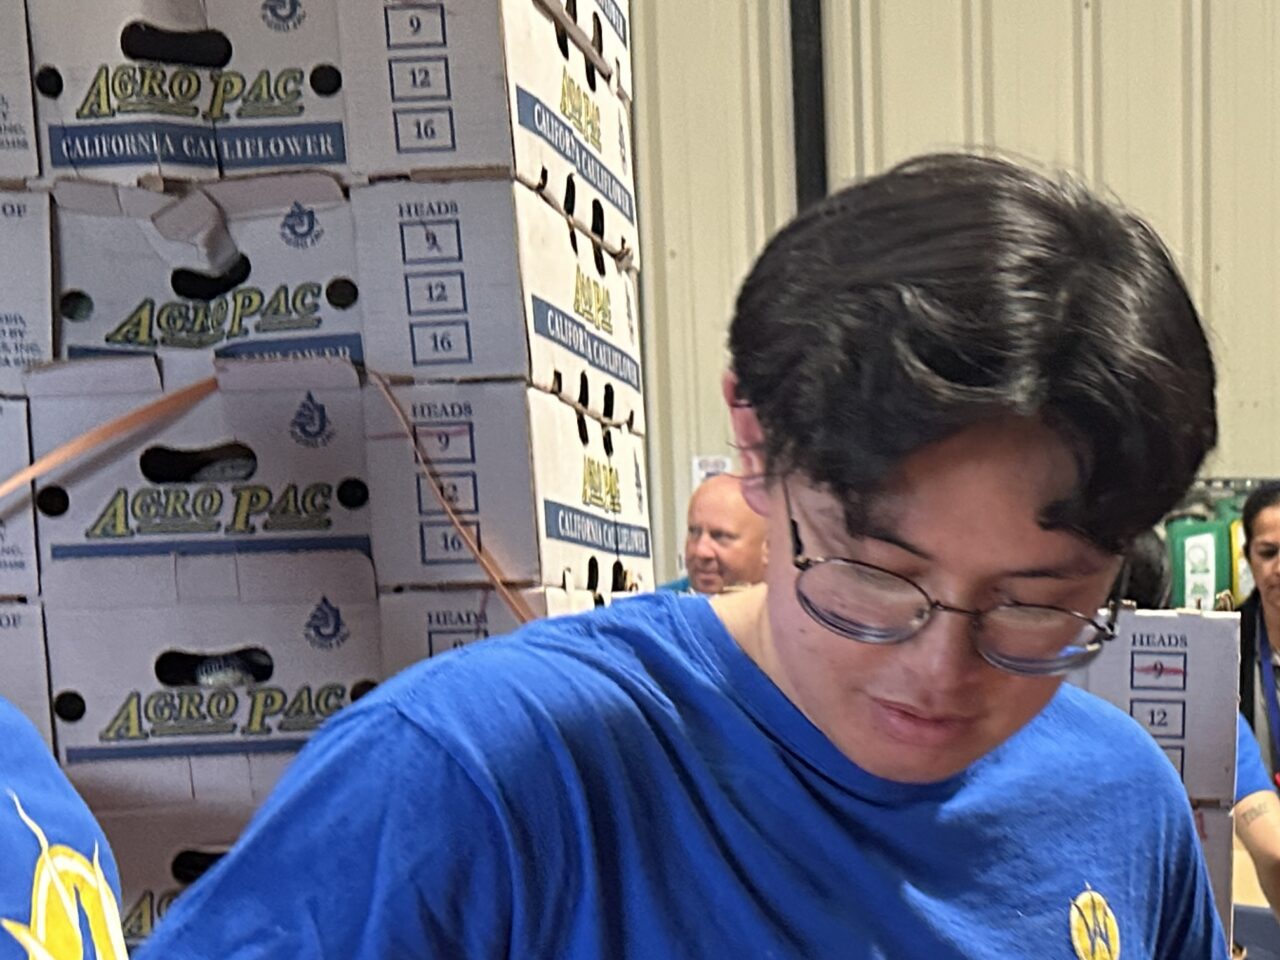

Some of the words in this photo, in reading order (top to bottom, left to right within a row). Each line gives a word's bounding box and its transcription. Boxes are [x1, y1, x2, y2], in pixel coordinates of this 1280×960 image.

[409, 14, 422, 35] 9
[410, 67, 431, 88] 12
[76, 63, 201, 119] AGRO
[202, 67, 305, 121] PAC
[415, 119, 436, 140] 16
[62, 132, 175, 159] CALIFORNIA
[399, 201, 459, 218] HEADS
[427, 281, 448, 303] 12
[227, 282, 322, 339] PAC
[431, 331, 453, 352] 16
[412, 403, 474, 418] HEADS
[438, 431, 450, 452] 9
[84, 486, 224, 539] AGRO
[223, 482, 333, 534] PAC
[441, 532, 463, 553] 16
[1131, 632, 1188, 648] HEADS
[1153, 660, 1164, 679] 9
[99, 687, 239, 742] AGRO
[240, 681, 347, 735] PAC
[1149, 708, 1168, 728] 12
